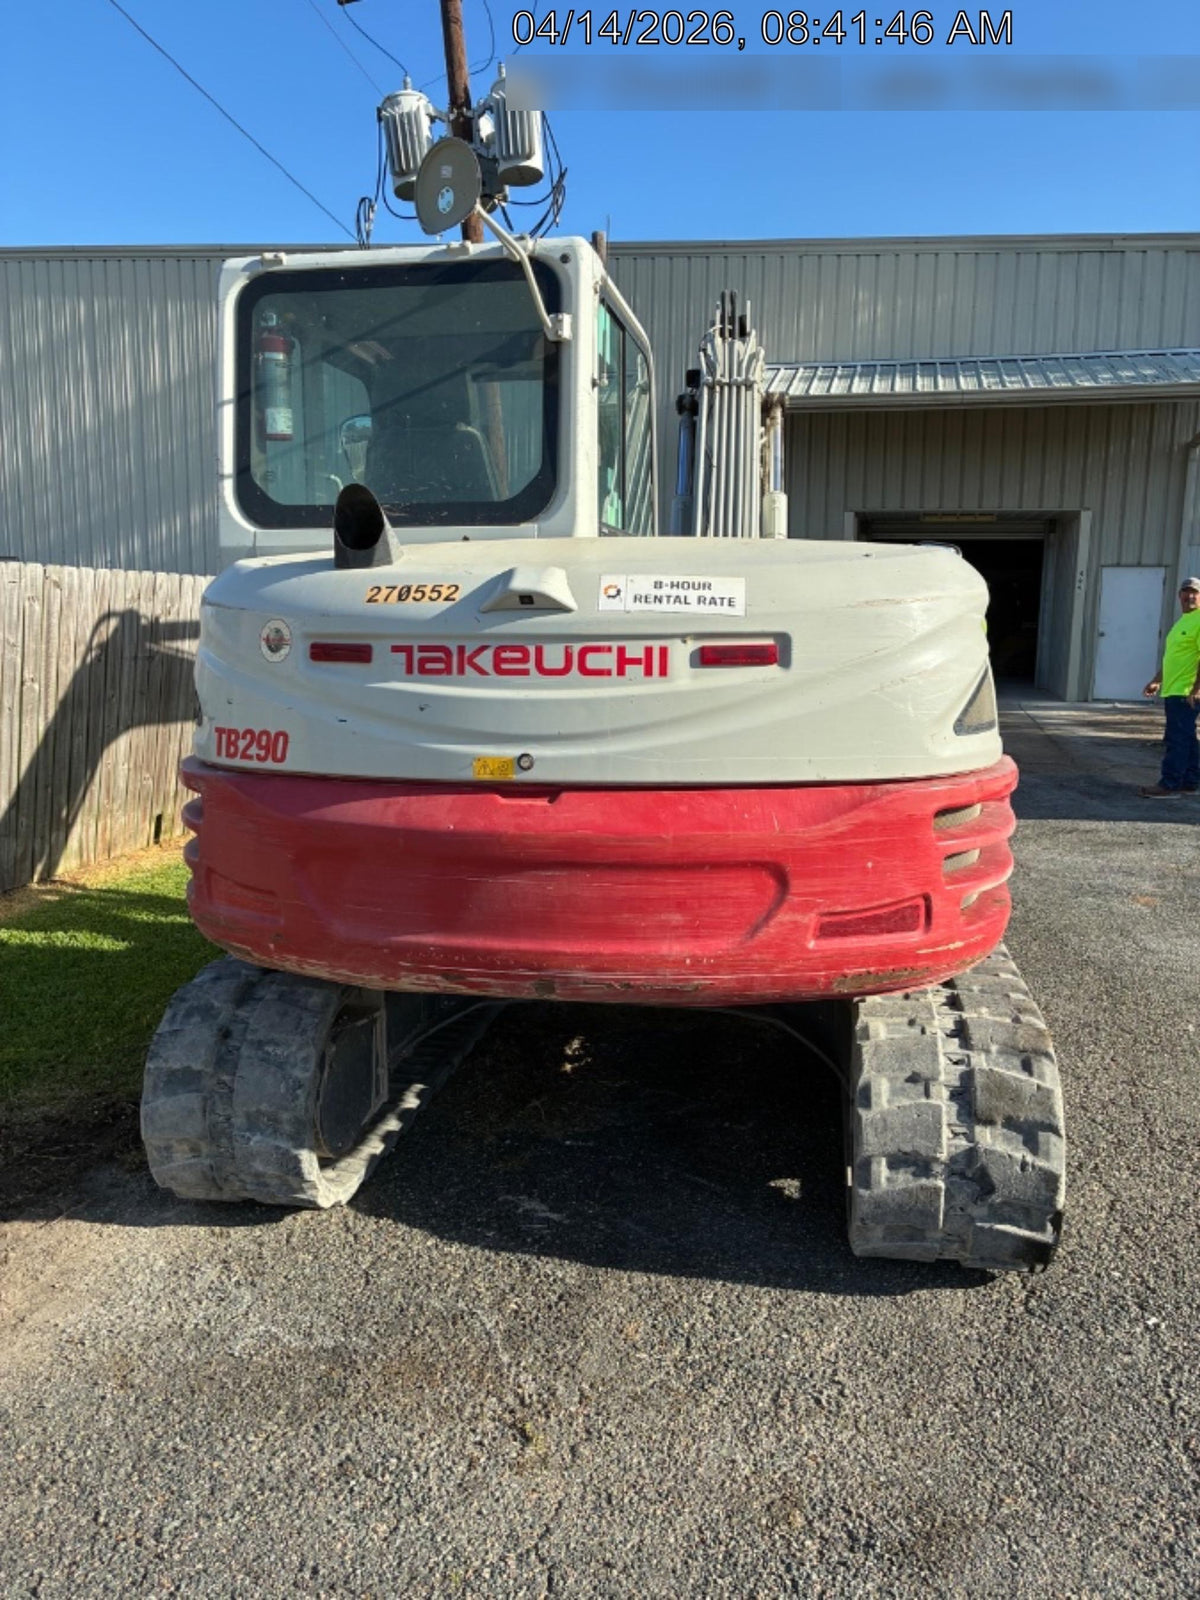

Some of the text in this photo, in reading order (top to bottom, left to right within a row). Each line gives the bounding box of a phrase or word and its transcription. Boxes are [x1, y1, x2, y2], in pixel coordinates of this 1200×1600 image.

[366, 584, 459, 604] 270552
[653, 580, 712, 591] 8-HOUR
[633, 593, 737, 608] RENTAL RATE
[214, 727, 289, 764] TB290
